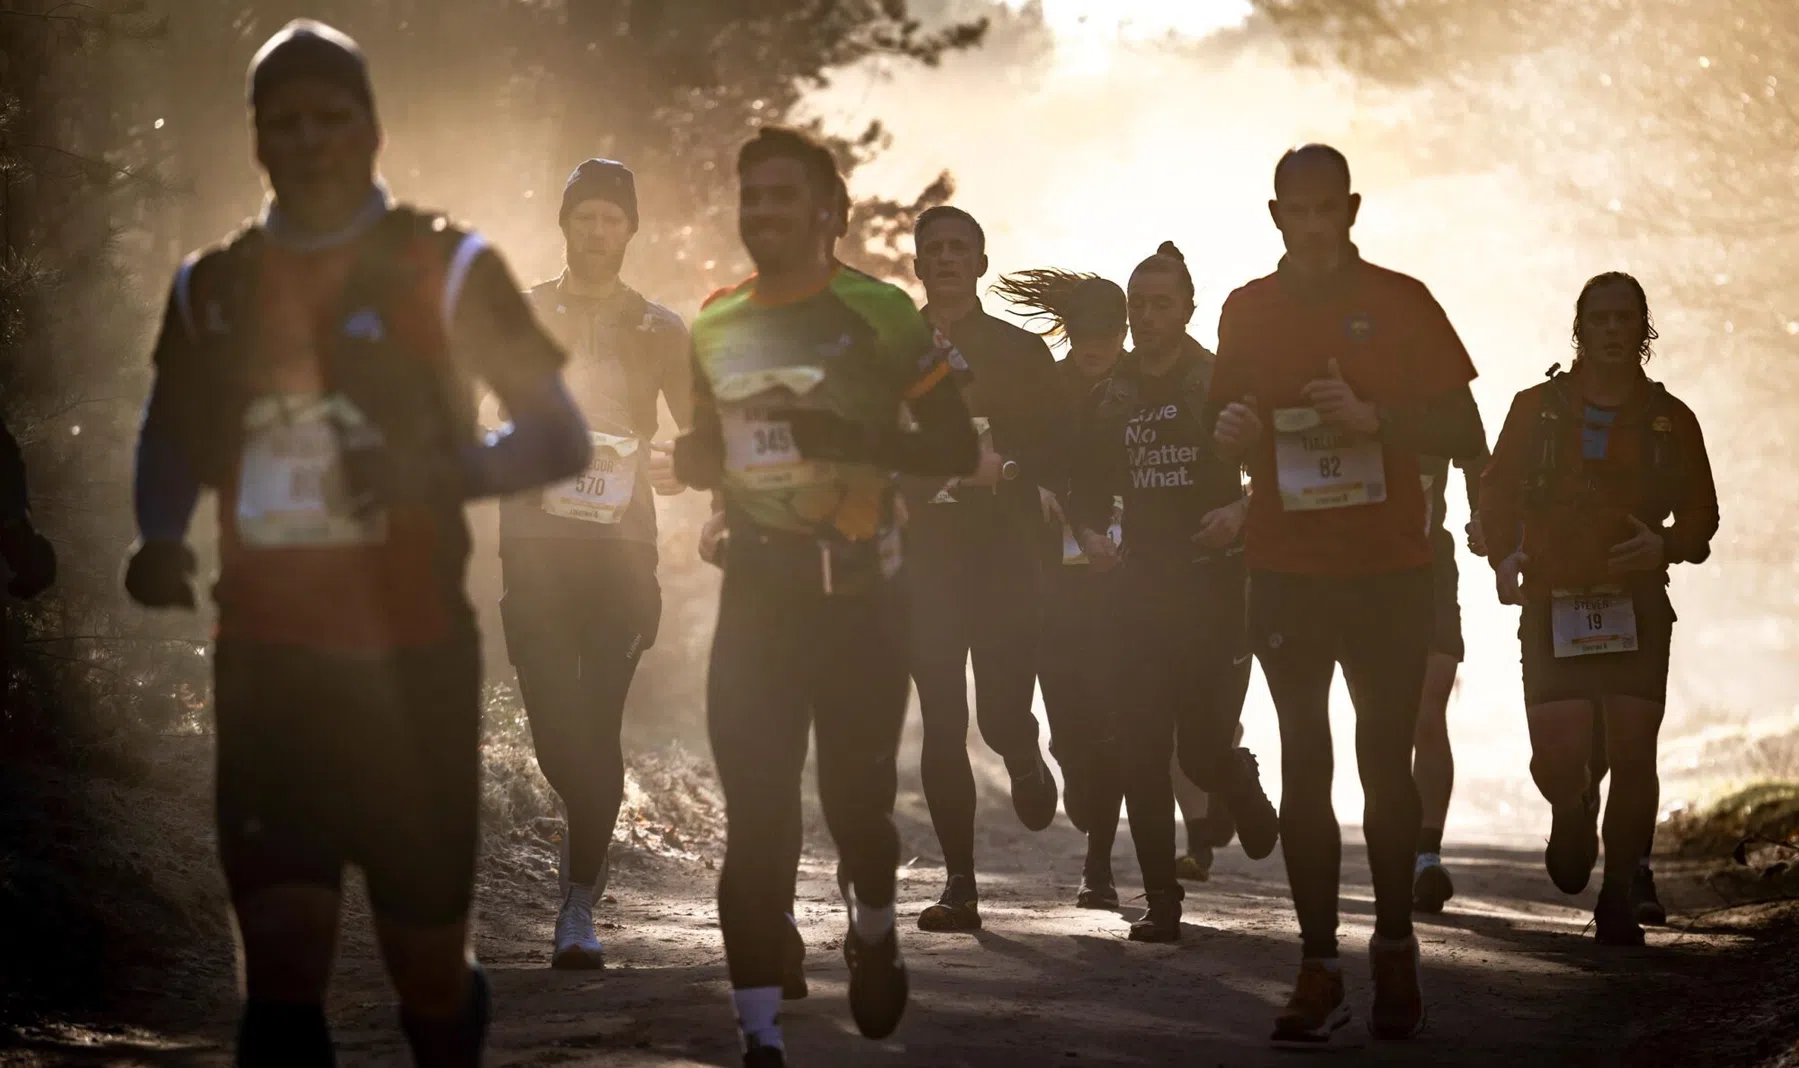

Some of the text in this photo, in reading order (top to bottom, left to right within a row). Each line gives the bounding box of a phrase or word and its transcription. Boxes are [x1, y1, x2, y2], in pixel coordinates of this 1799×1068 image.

[754, 428, 790, 456] 345
[1125, 425, 1156, 446] No
[1126, 444, 1199, 467] Matter
[1129, 466, 1194, 489] What.
[1320, 456, 1343, 478] 82
[576, 475, 606, 497] 570
[1586, 613, 1603, 631] 19
